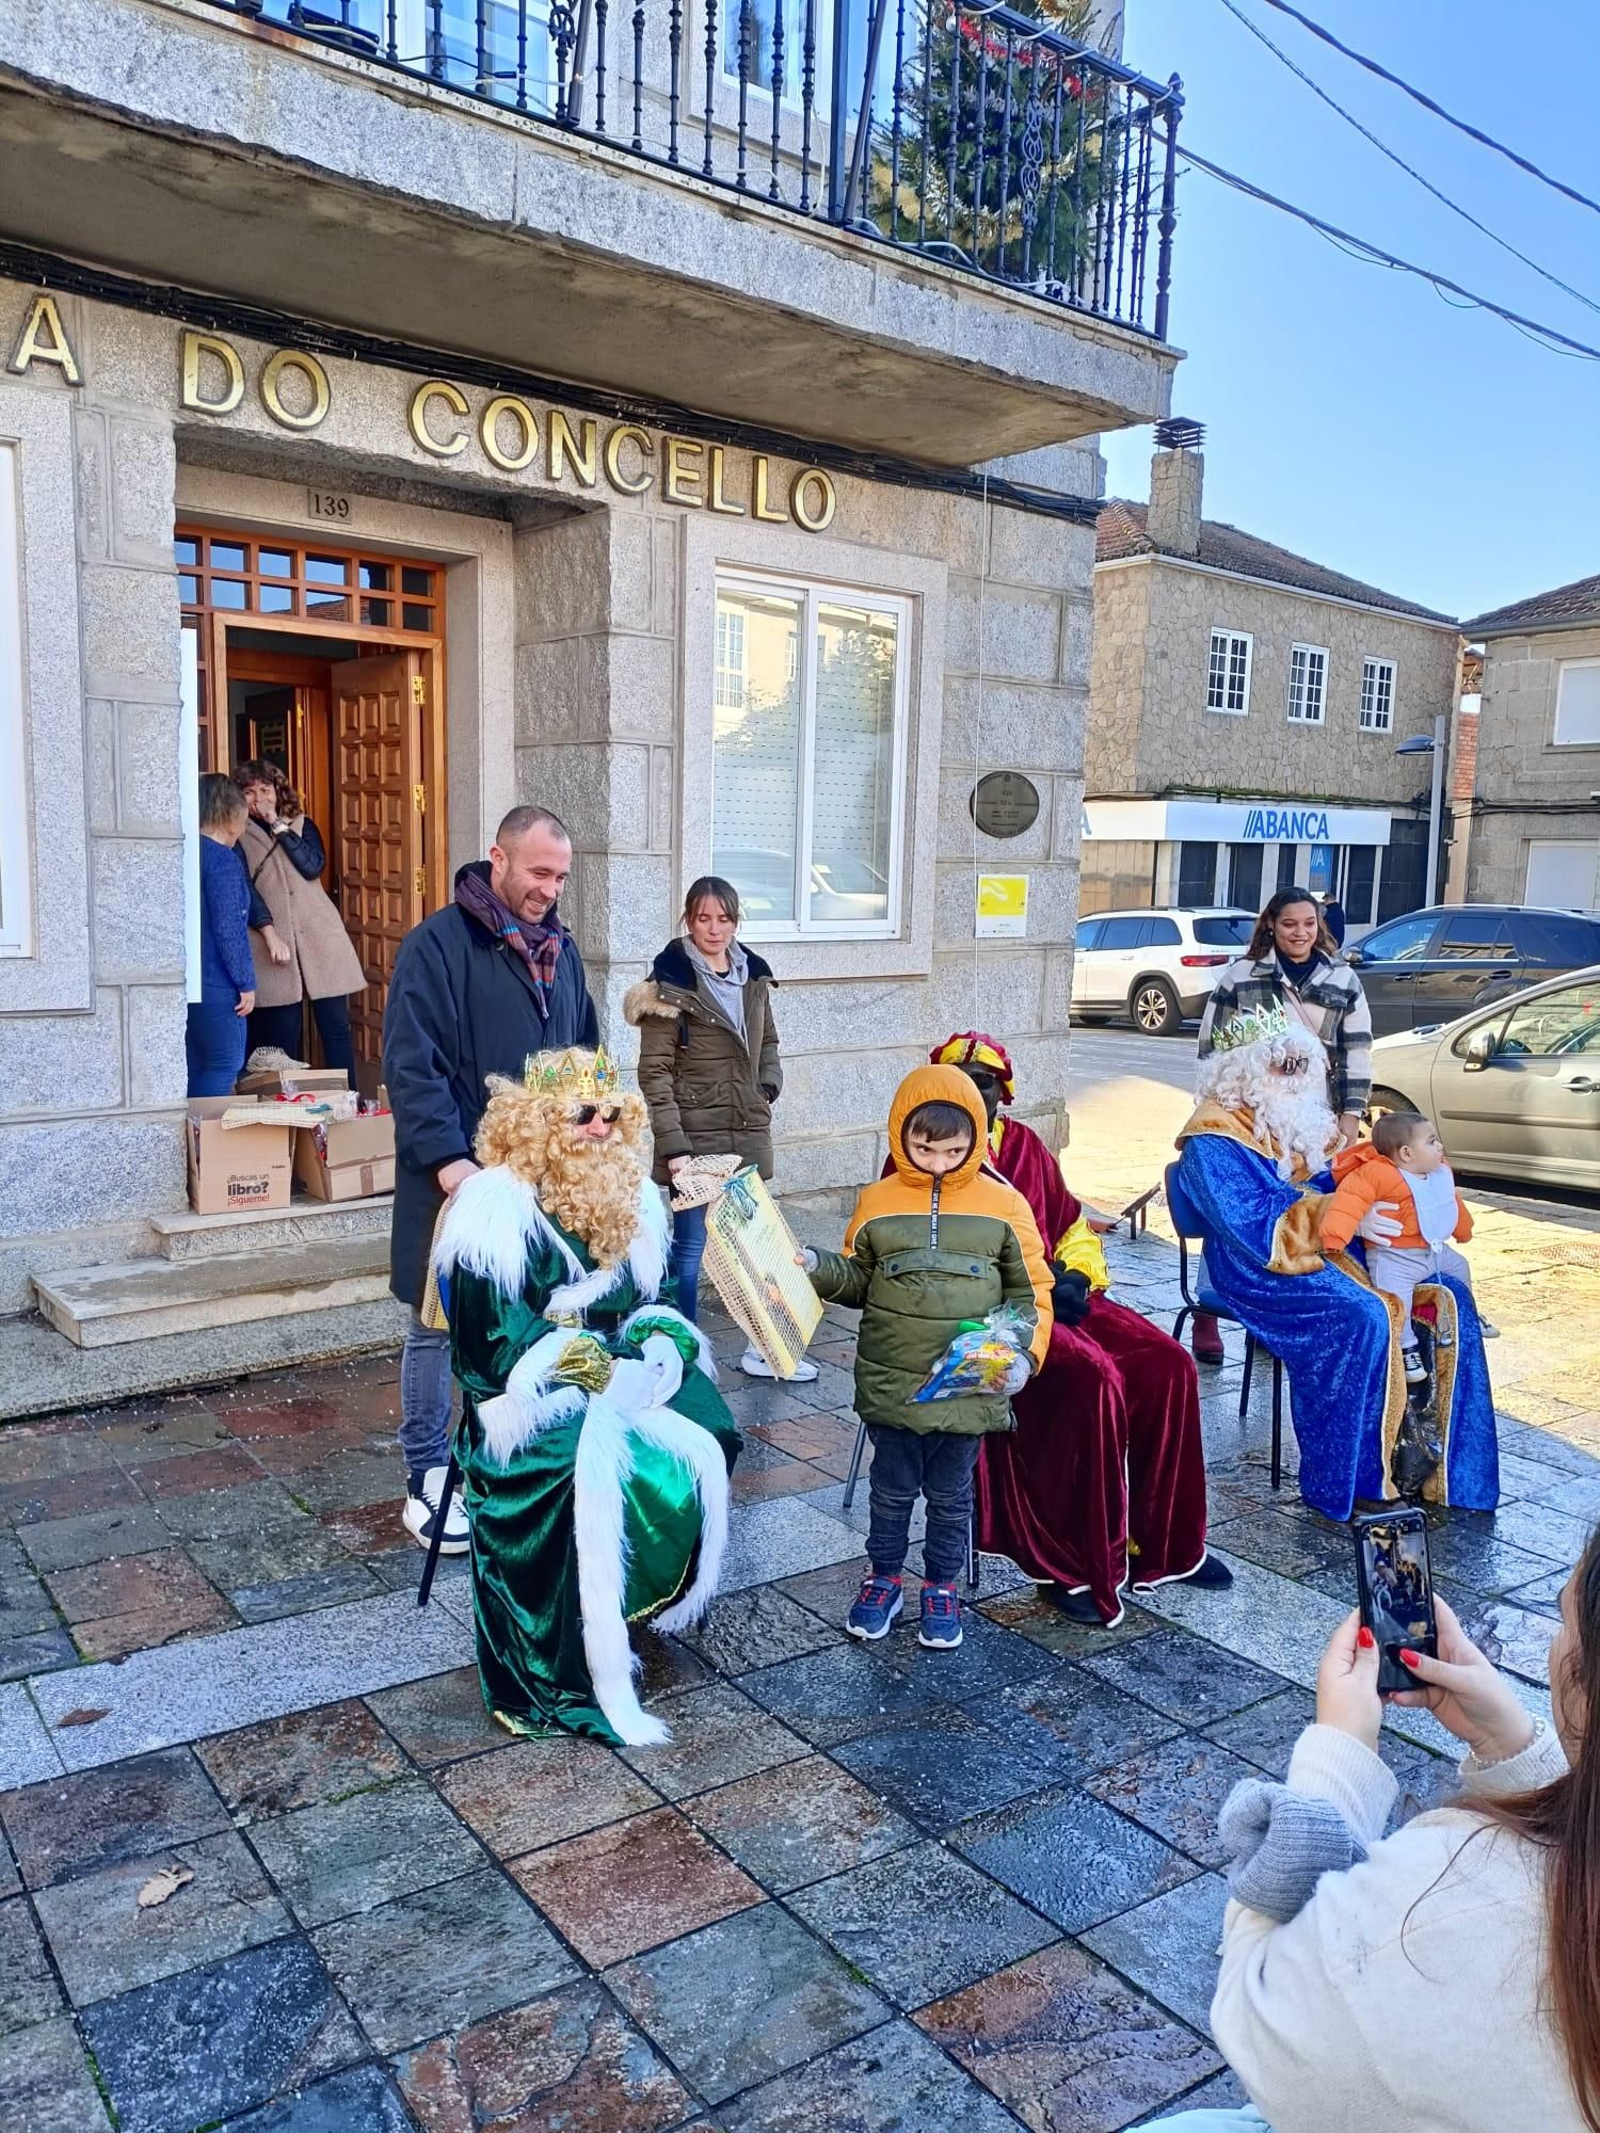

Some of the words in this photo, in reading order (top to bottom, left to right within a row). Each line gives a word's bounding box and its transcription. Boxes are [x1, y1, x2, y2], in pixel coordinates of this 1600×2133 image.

[178, 327, 332, 432] DO
[407, 379, 837, 533] CONCELLO
[314, 493, 350, 518] 139
[259, 1173, 270, 1181] un
[227, 1181, 270, 1196] libro?
